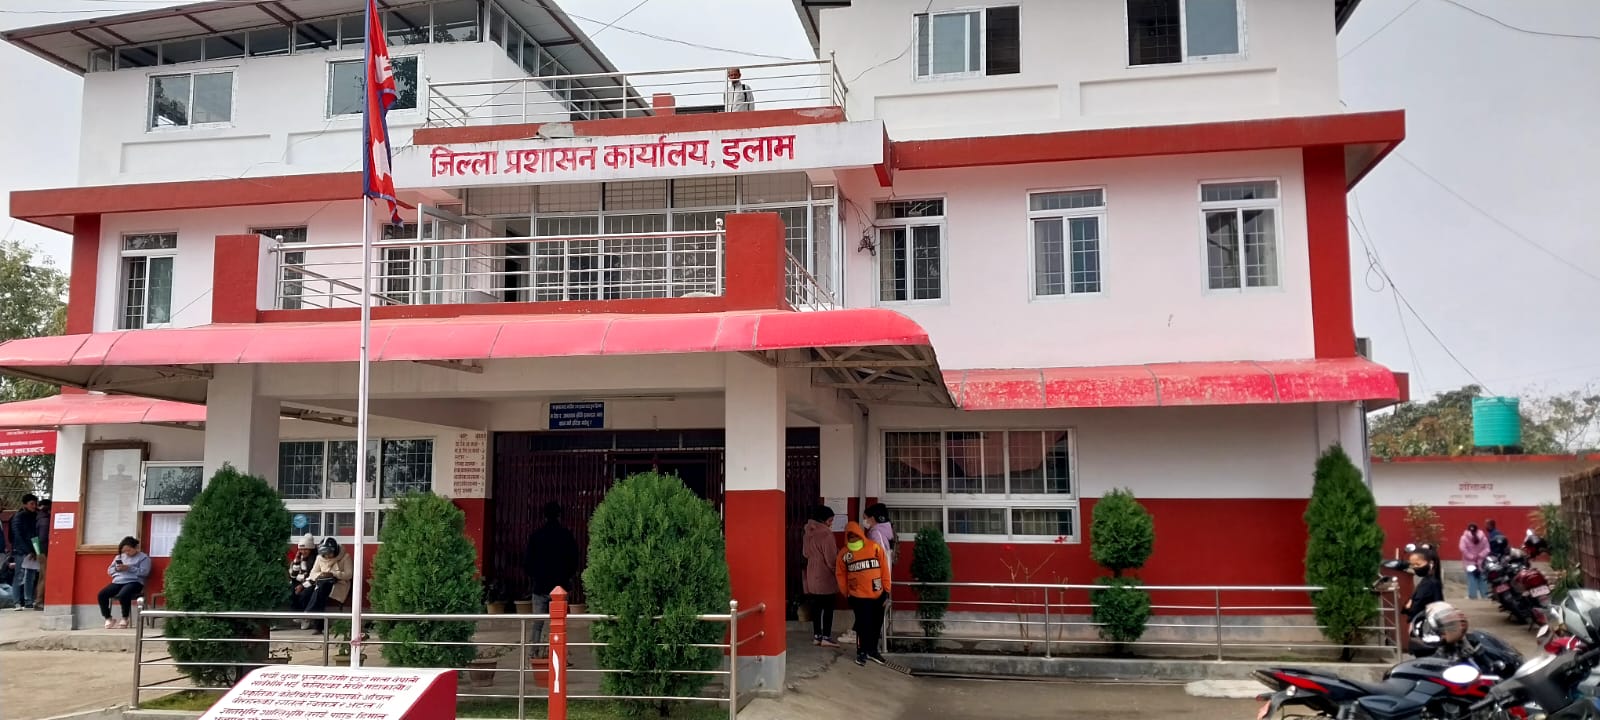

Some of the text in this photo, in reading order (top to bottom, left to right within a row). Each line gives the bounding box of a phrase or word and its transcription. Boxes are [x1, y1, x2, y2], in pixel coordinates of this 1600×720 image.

[430, 134, 796, 177] जिल्ला प्रशासन कार्यालय, इलाम
